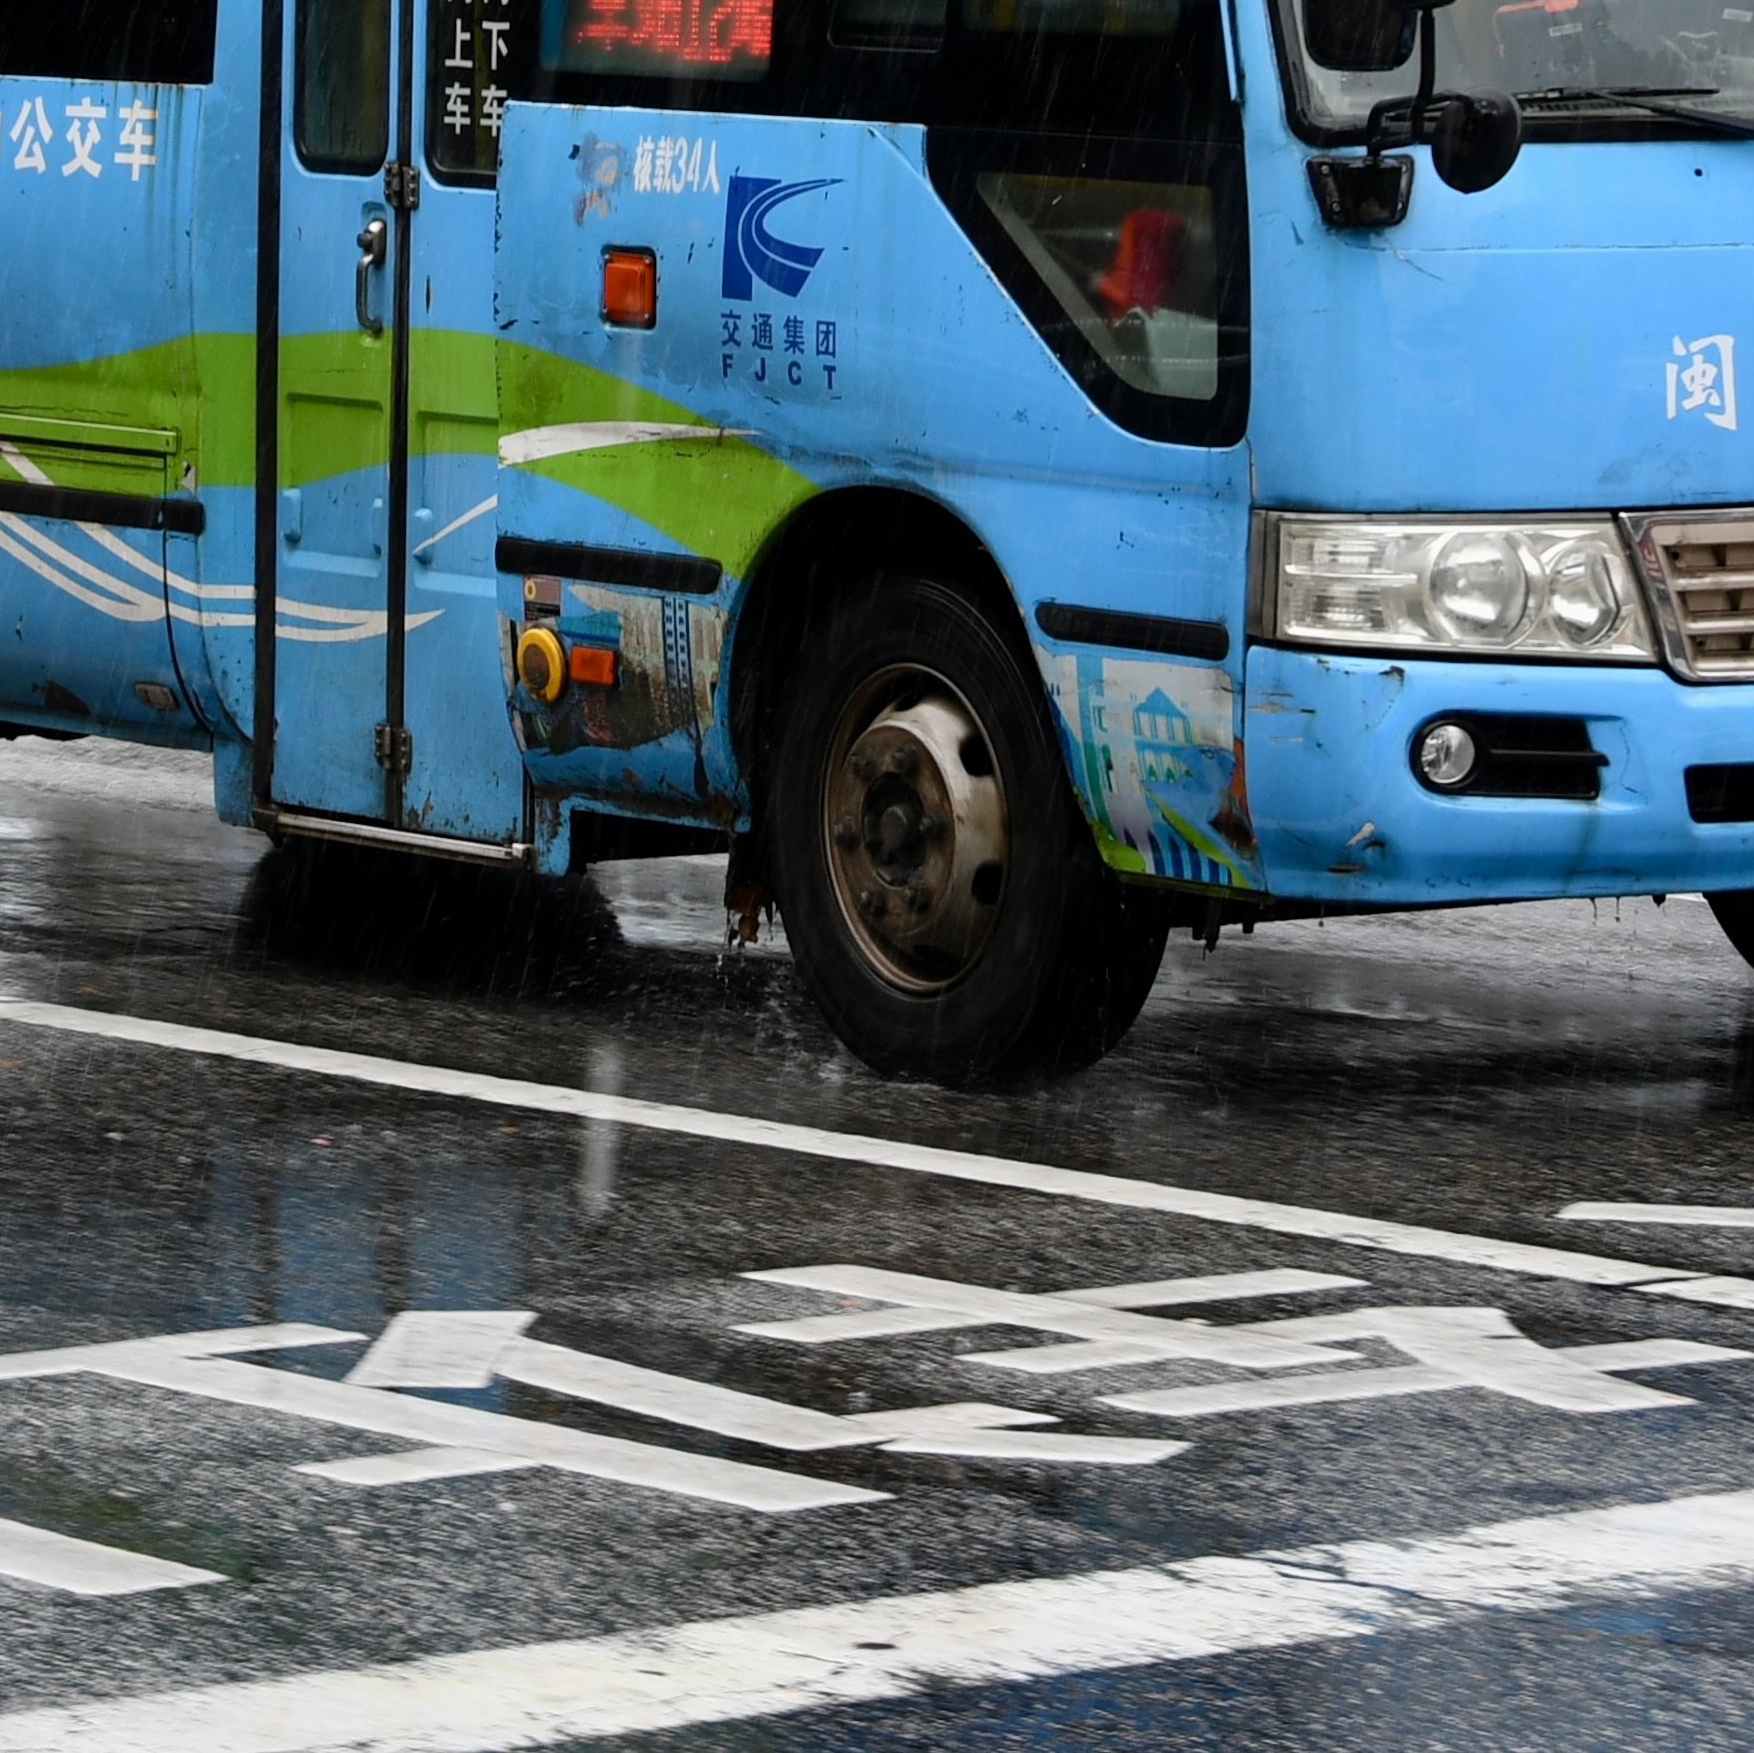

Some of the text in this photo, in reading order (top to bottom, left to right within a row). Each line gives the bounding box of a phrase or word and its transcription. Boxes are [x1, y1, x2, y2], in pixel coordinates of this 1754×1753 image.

[633, 135, 720, 195] 核载34人
[720, 311, 837, 359] 交通集团
